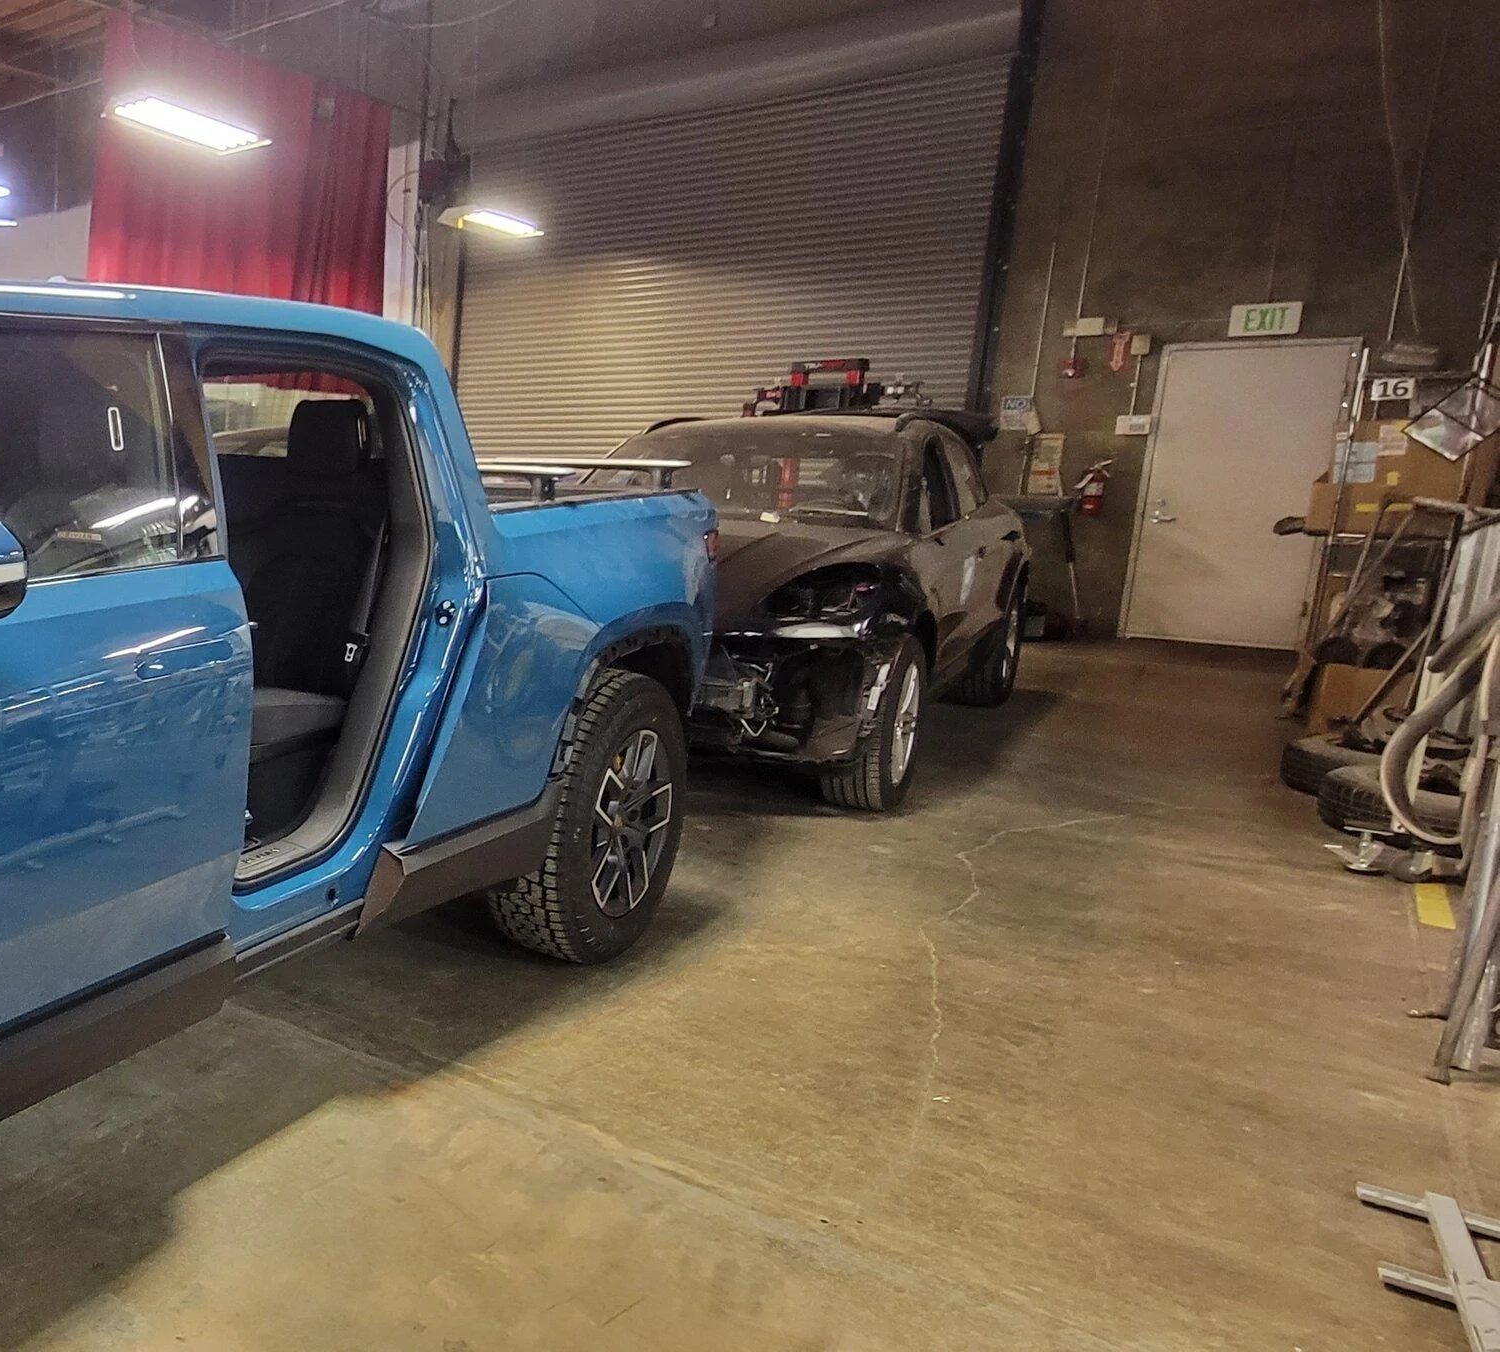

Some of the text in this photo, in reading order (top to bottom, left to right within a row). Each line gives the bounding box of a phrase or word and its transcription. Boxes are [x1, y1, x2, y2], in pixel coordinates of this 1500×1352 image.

[1243, 307, 1290, 332] EXIT
[1376, 380, 1409, 398] 16
[1005, 399, 1027, 409] NO
